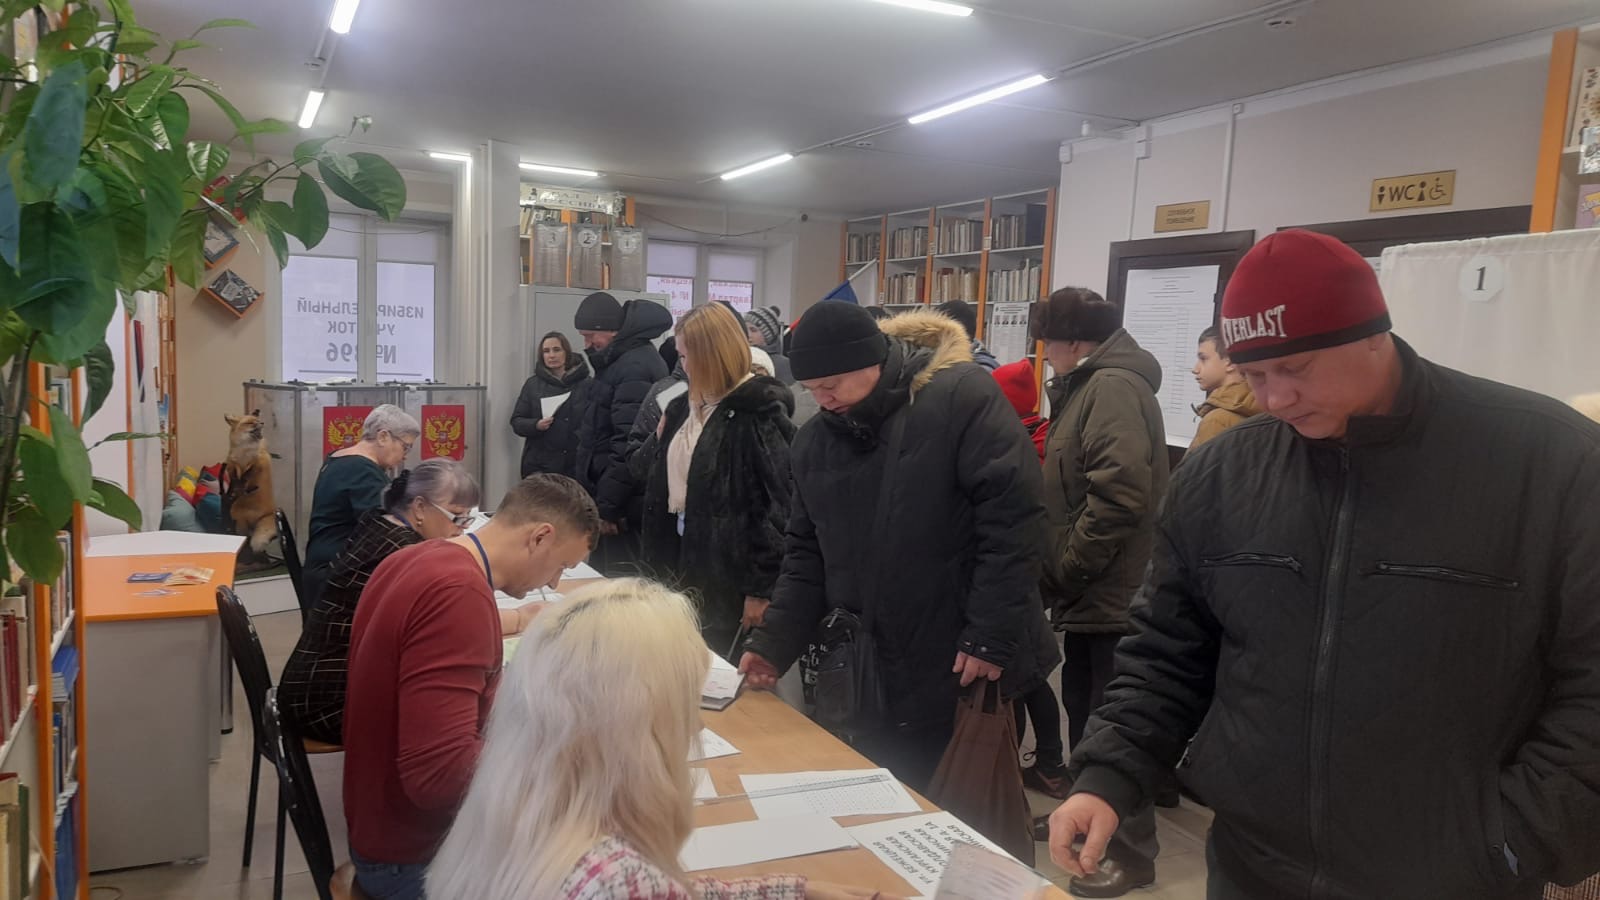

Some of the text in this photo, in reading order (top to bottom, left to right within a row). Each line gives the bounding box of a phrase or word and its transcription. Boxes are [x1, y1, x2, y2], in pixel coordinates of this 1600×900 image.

[1388, 184, 1416, 201] WC
[582, 232, 592, 245] 2
[1473, 266, 1487, 291] 1
[872, 841, 919, 873] БЕЖЕЦКАЯ
[885, 836, 940, 873] КУРГАНСКАЯ
